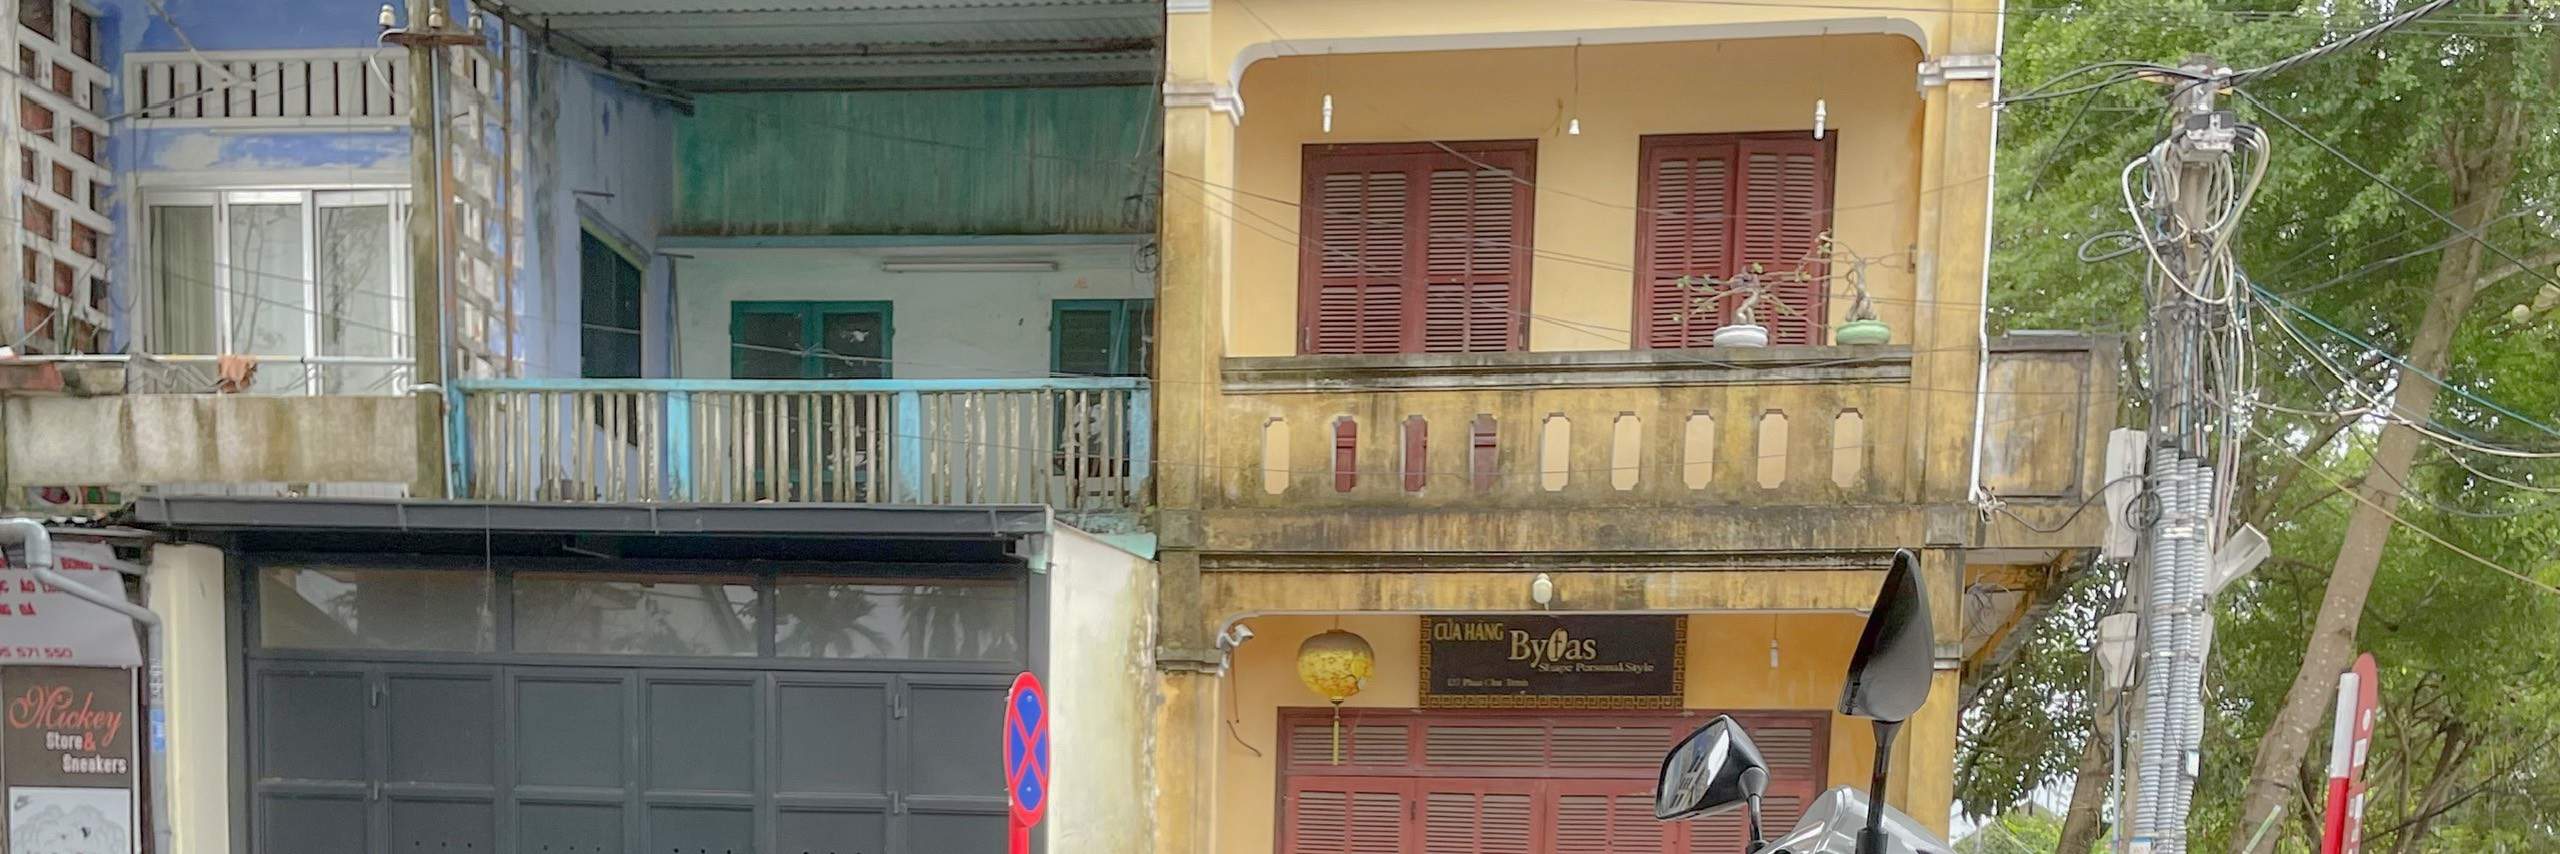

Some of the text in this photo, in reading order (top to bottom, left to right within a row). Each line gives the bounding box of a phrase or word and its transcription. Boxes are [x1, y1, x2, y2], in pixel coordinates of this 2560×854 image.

[1624, 662, 1655, 674] Style
[8, 685, 123, 748] Mickey
[46, 731, 97, 750] Store &
[62, 753, 128, 774] Sneakers
